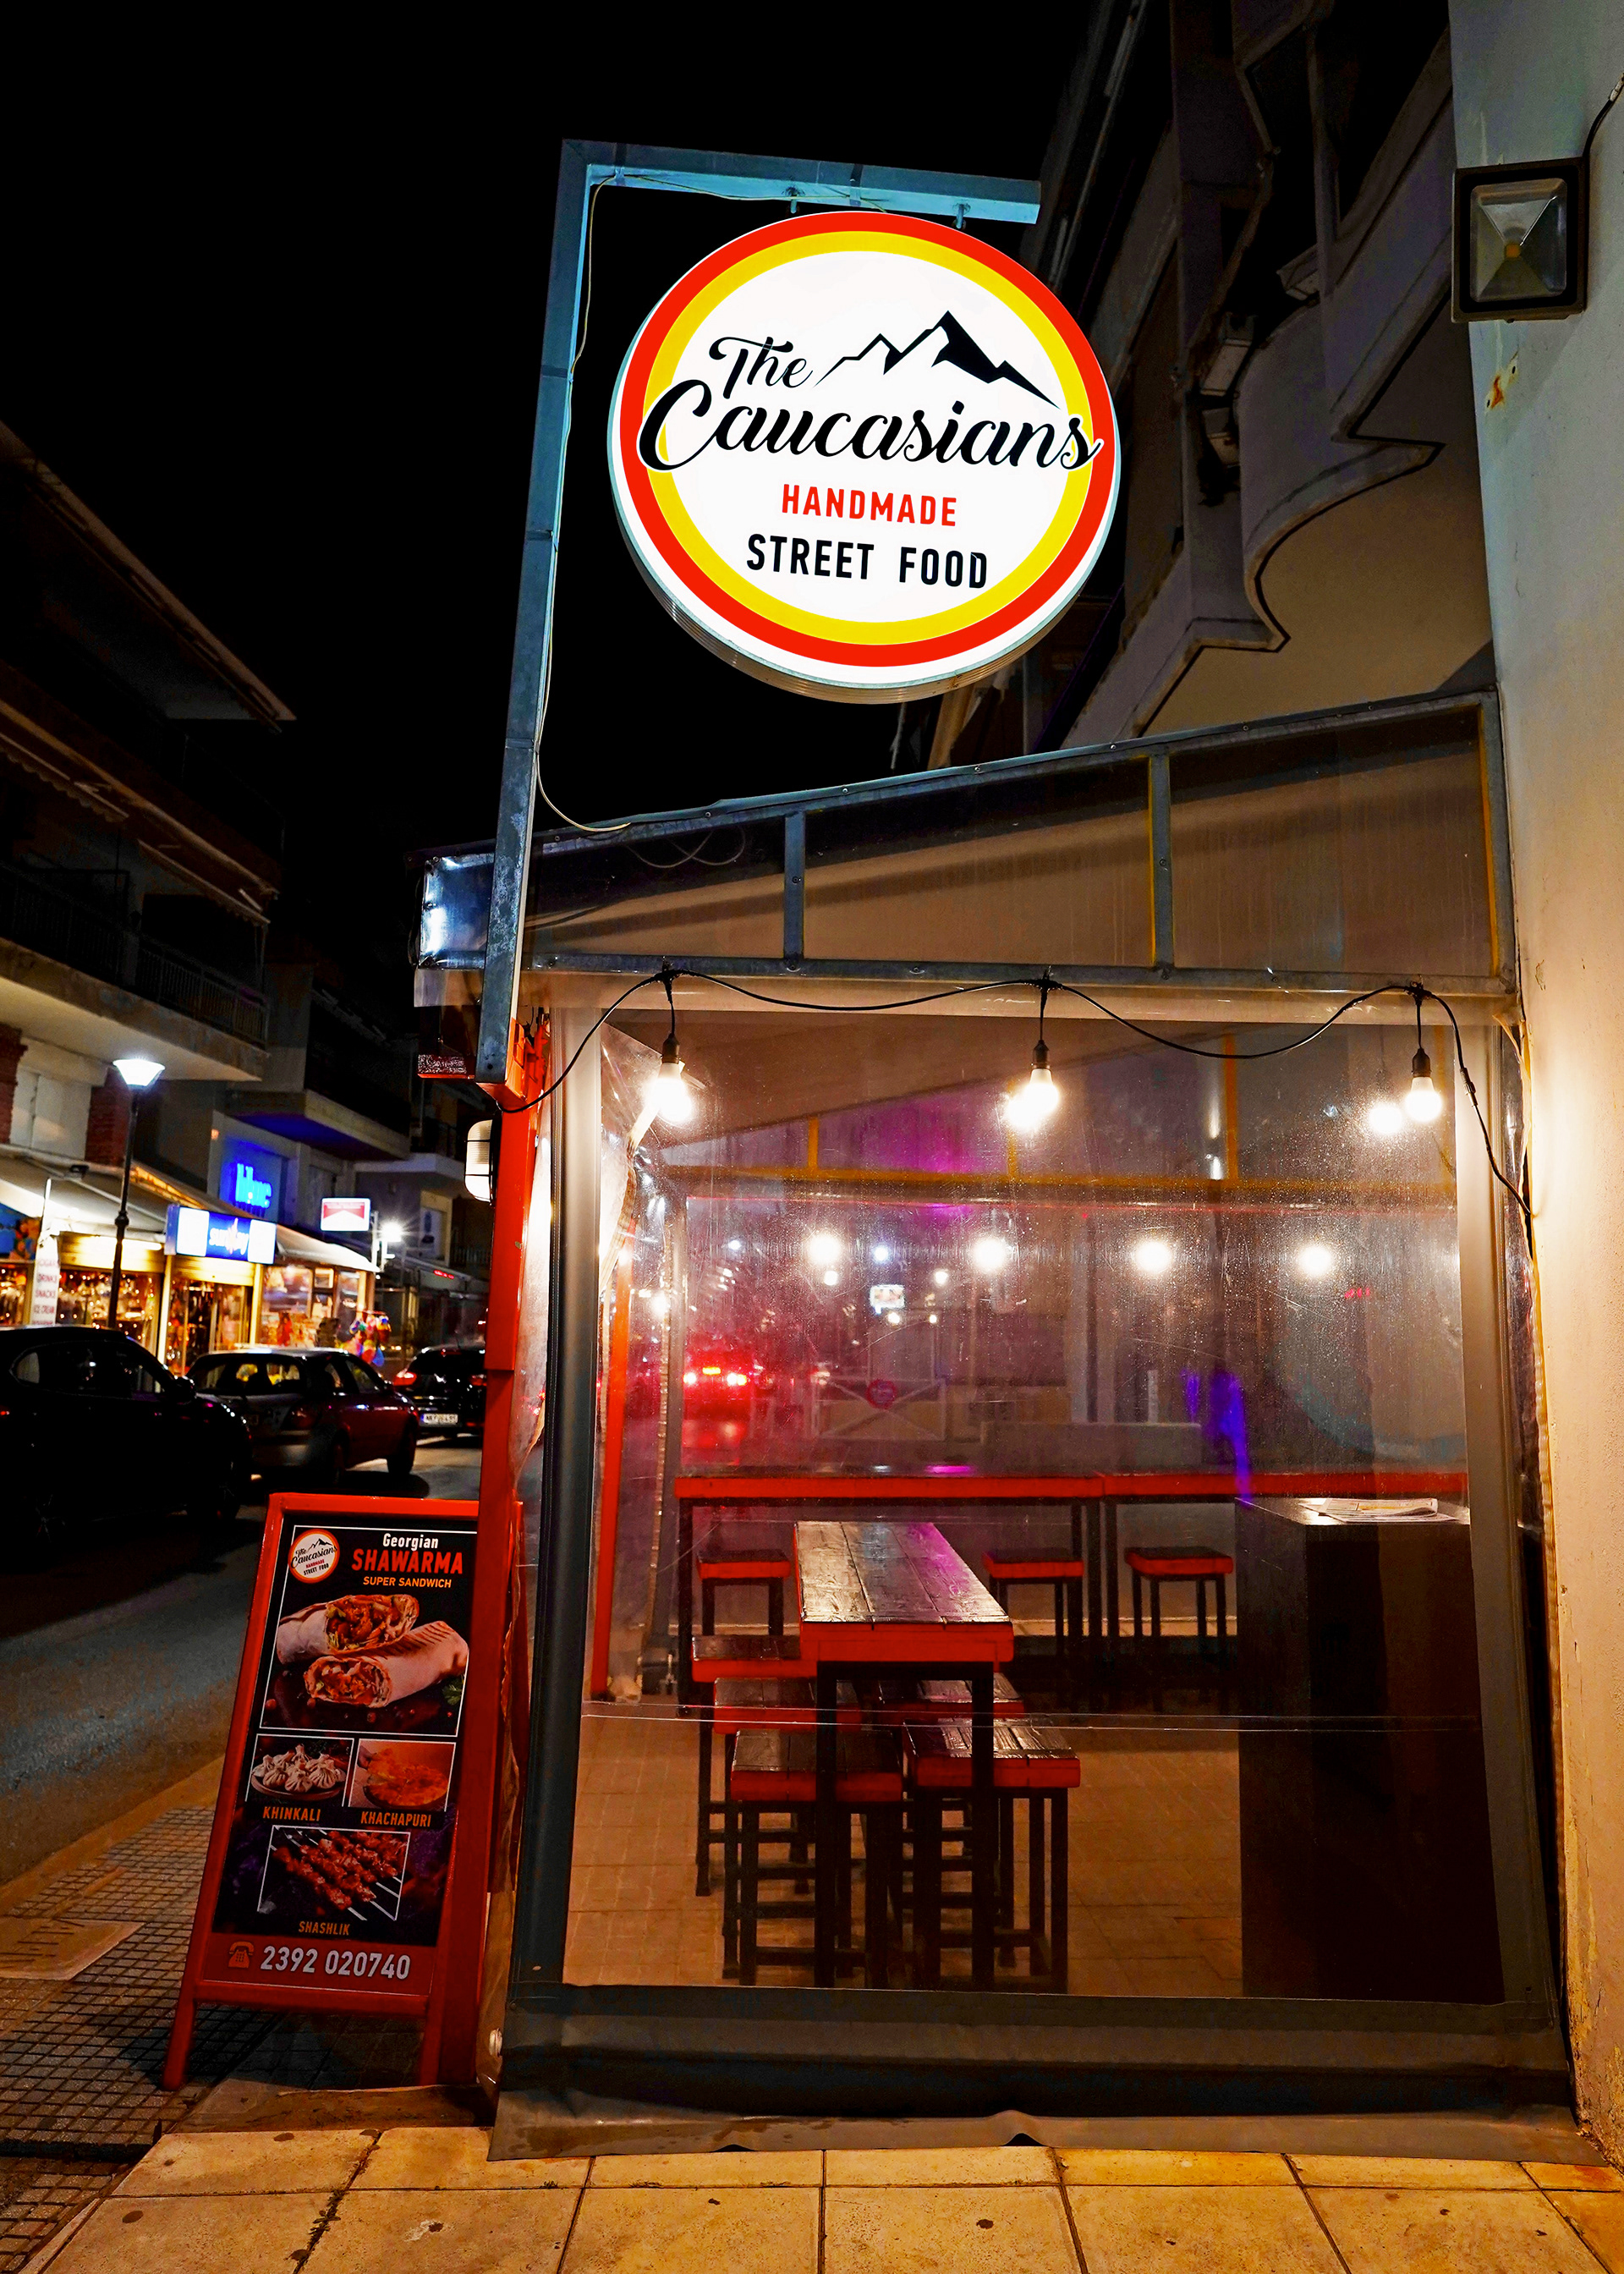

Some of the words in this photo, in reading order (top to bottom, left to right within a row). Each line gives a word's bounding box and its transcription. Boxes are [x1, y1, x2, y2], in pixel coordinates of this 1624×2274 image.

[709, 337, 813, 398] The
[639, 379, 1101, 470] Caucasians
[782, 484, 957, 526] HANDMADE
[747, 534, 875, 579] STREET
[899, 547, 988, 589] FOOD
[295, 1547, 308, 1558] The
[382, 1532, 439, 1552] Georgian
[291, 1545, 337, 1569] Caucasians
[351, 1548, 463, 1574] SHAWARMA
[303, 1566, 318, 1576] STREET
[318, 1563, 330, 1571] FOOD
[363, 1576, 396, 1586] SUPER
[398, 1577, 452, 1588] SANDWICH
[262, 1806, 321, 1821] KHINKALI
[360, 1810, 432, 1827] KHACHAPURI
[298, 1920, 351, 1936] SHASHLIK
[260, 1945, 319, 1974] 2392
[324, 1949, 411, 1980] 020740
